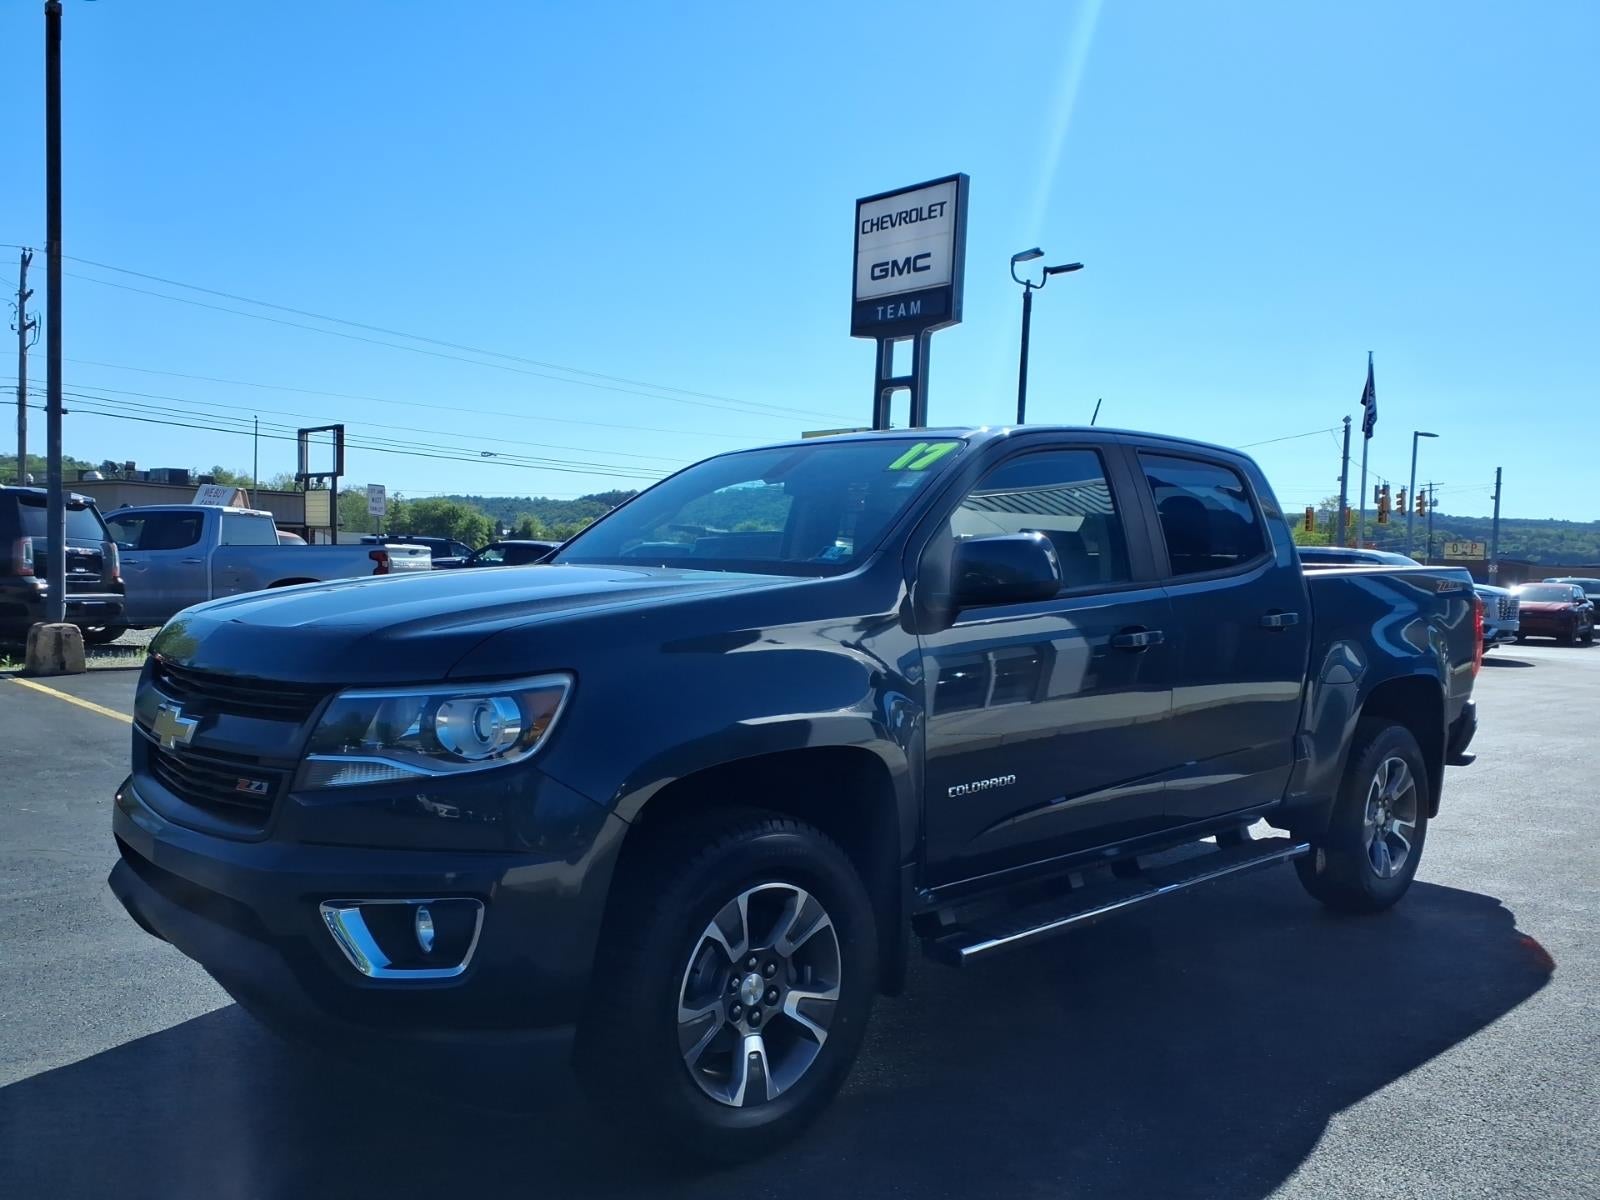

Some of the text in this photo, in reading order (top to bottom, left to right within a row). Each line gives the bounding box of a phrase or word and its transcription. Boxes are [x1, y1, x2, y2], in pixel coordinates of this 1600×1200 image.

[861, 201, 948, 235] CHEVROLET
[870, 252, 932, 281] GMC
[876, 300, 921, 321] TEAM
[888, 442, 959, 471] 17
[236, 778, 269, 795] Z71
[948, 774, 1016, 798] COLORADO
